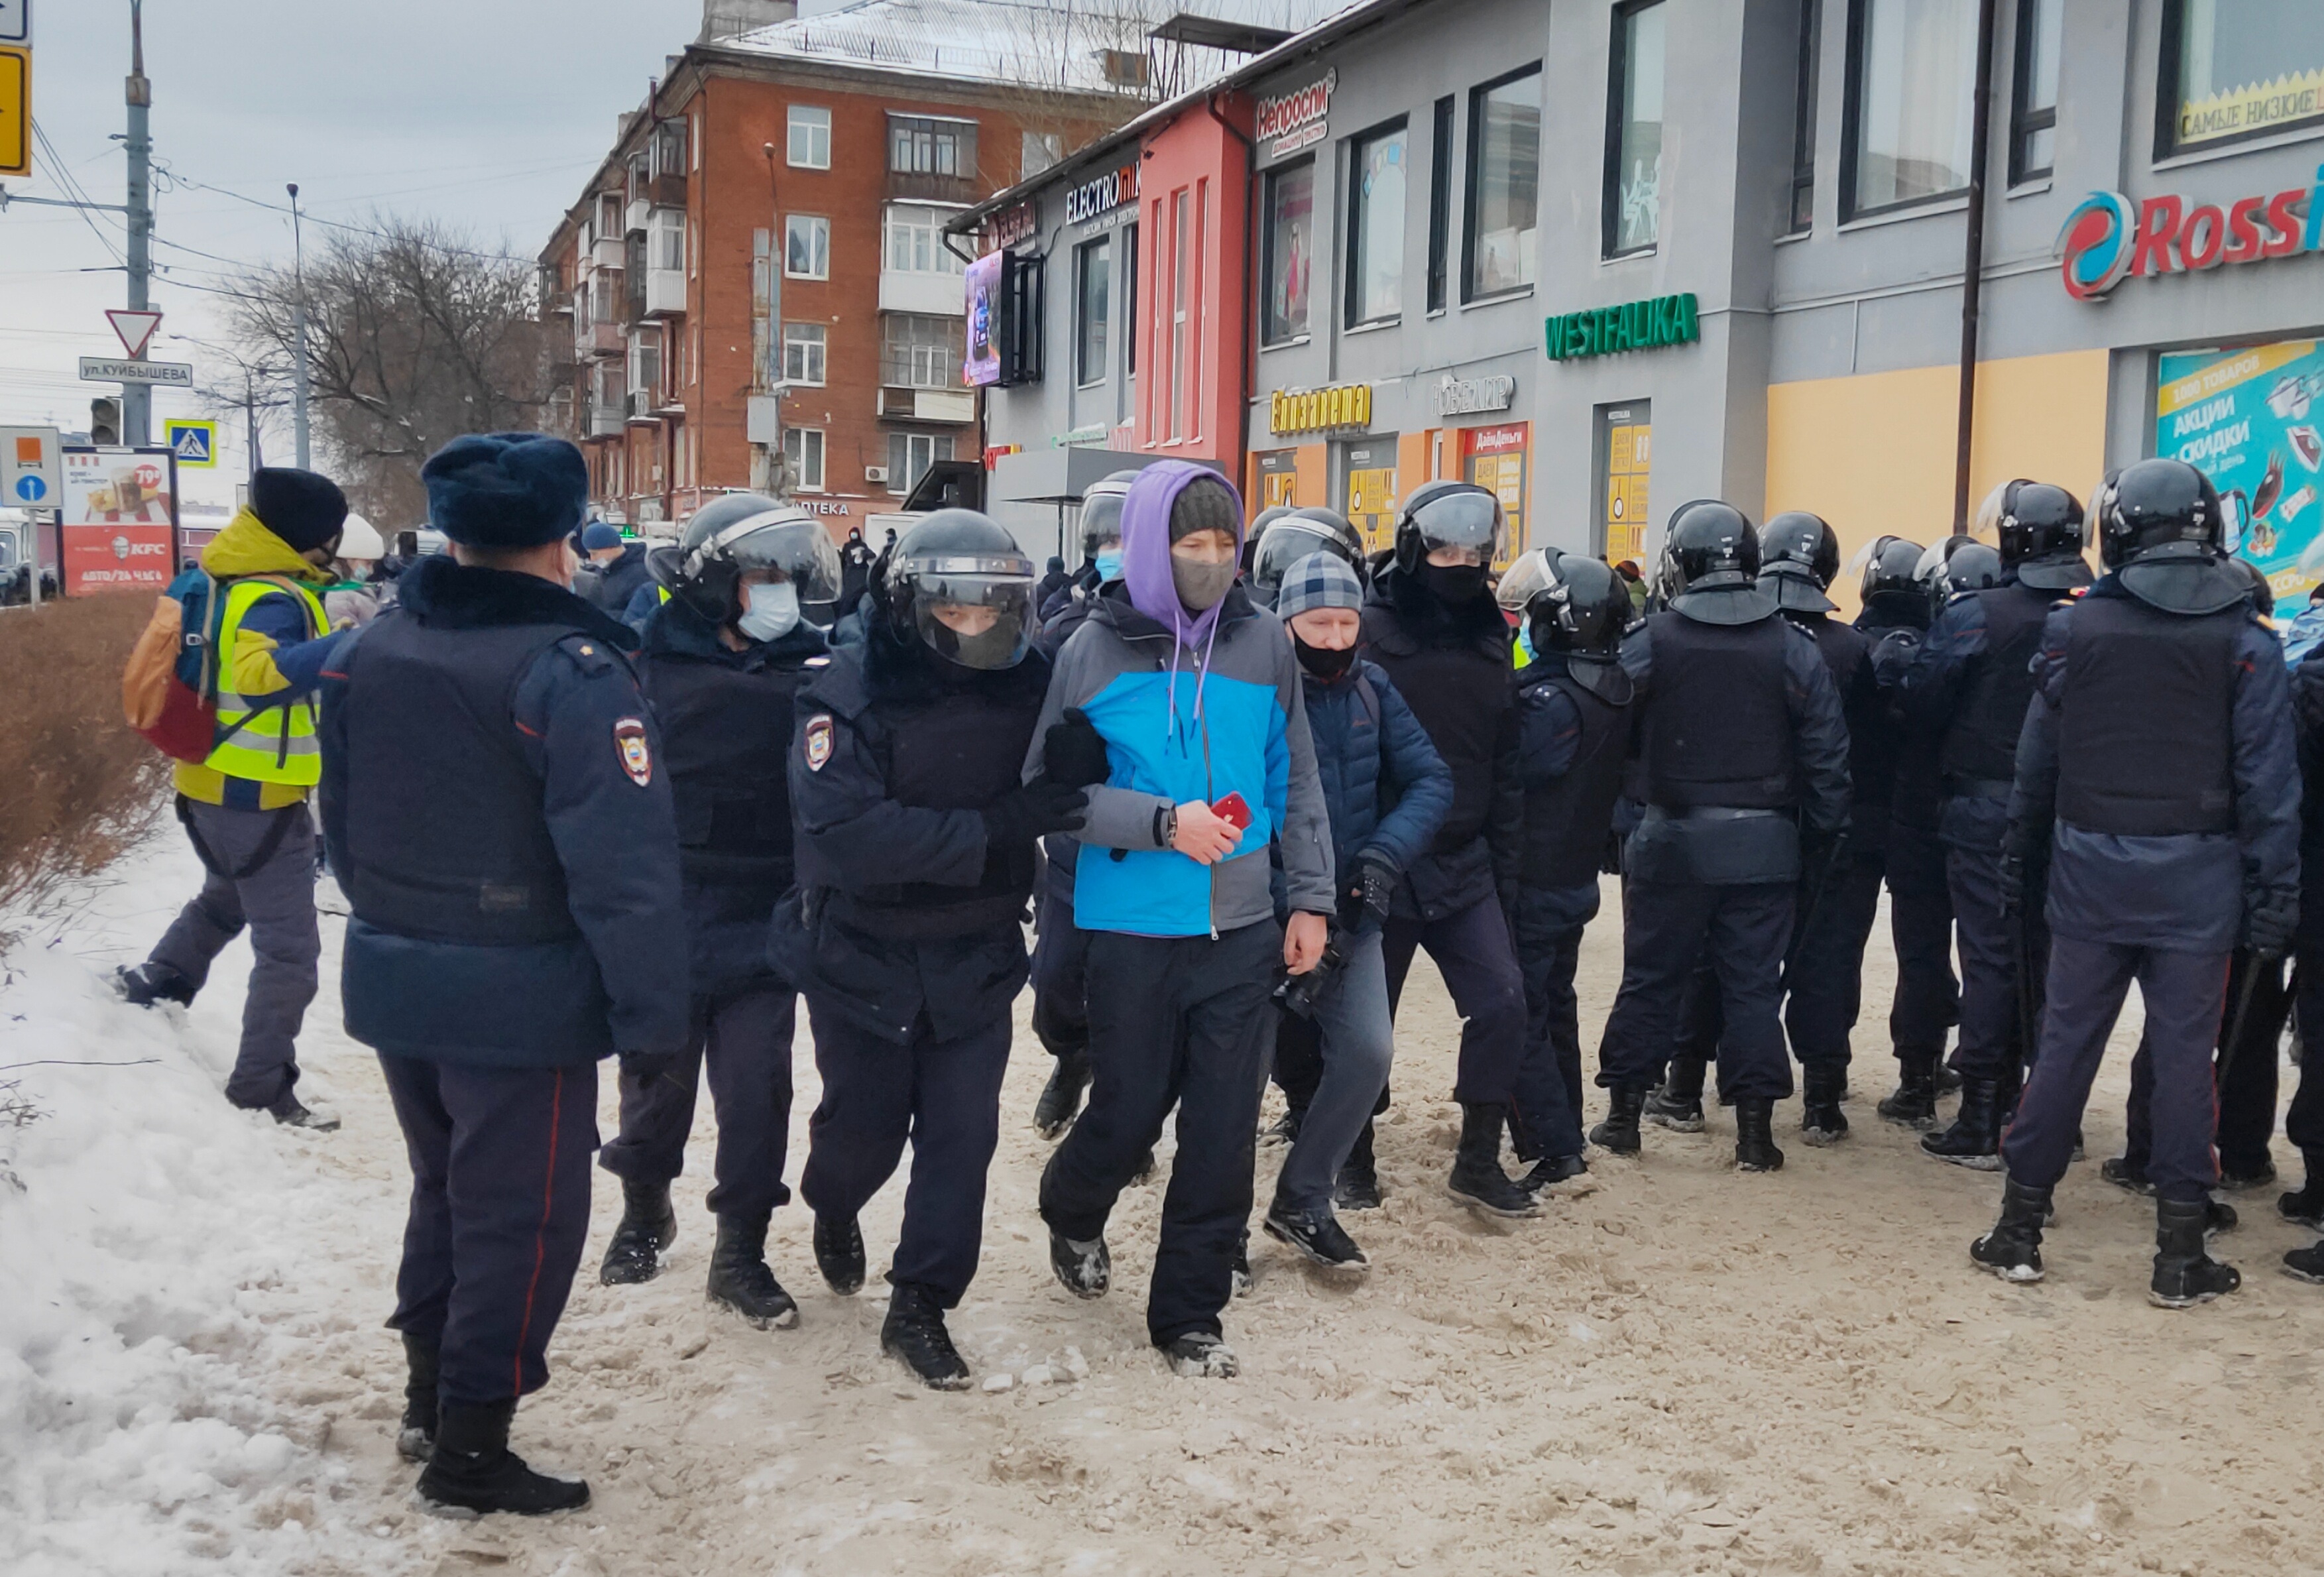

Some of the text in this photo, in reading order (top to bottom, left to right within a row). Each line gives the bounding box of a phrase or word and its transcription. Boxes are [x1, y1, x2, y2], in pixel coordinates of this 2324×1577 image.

[2182, 105, 2241, 137] САМЫЕ
[2246, 88, 2315, 125] НИЗКИЕ
[1545, 292, 1699, 361] WESTFALIKA
[2203, 355, 2260, 390] ТОВАРОВ
[1432, 375, 1513, 416] ЮВЕЛИР
[2174, 394, 2235, 438] АКЦИИ
[2179, 420, 2250, 464] СКИДКИ
[793, 500, 849, 516] ПТЕКА
[131, 543, 166, 555] KFC
